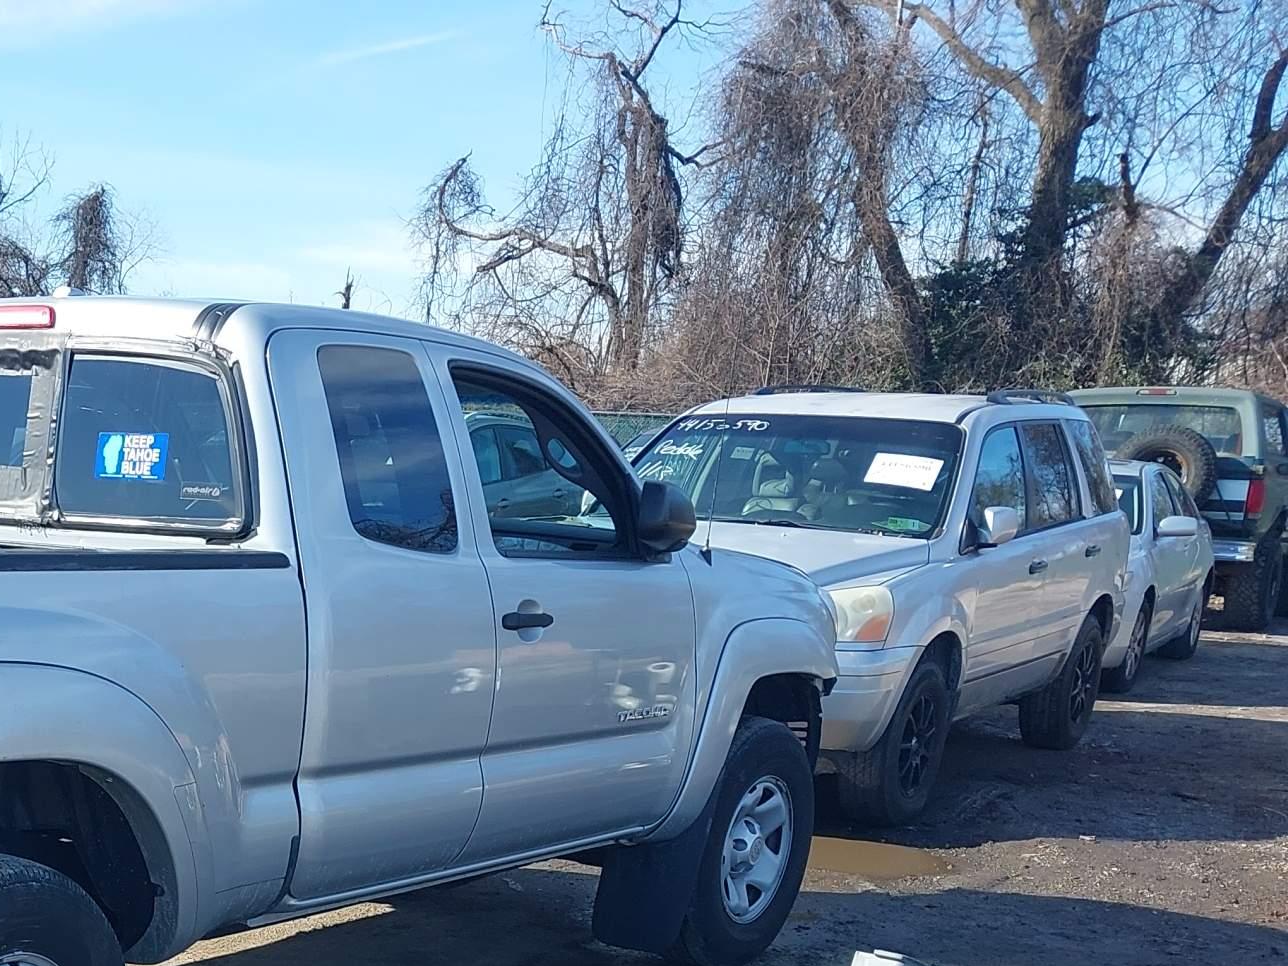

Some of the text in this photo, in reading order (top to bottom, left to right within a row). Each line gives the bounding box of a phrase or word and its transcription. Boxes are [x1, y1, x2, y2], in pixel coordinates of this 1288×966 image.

[123, 434, 155, 448] KEEP
[122, 447, 161, 463] TAHOE
[120, 461, 152, 475] BLUE
